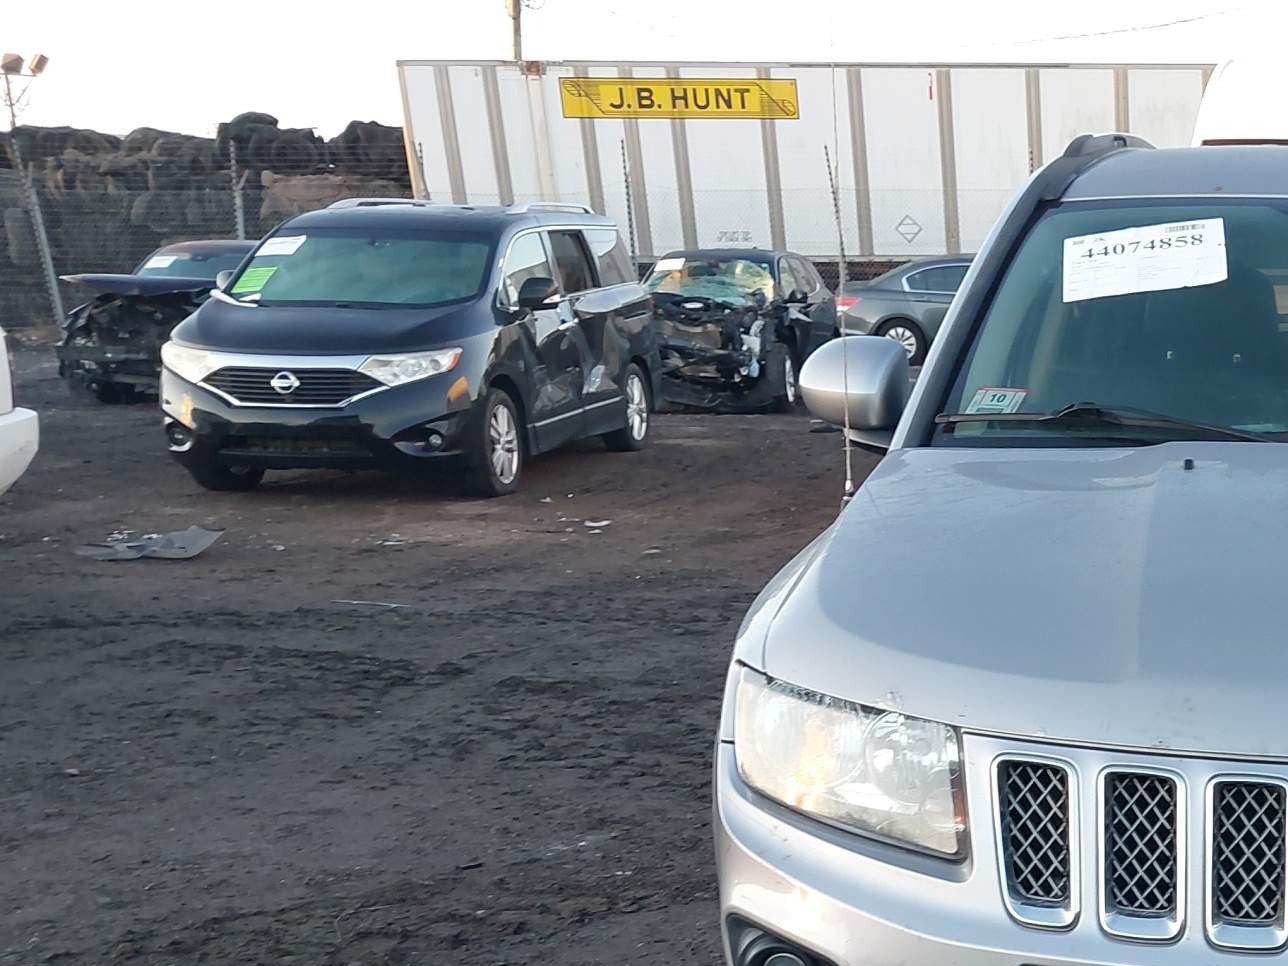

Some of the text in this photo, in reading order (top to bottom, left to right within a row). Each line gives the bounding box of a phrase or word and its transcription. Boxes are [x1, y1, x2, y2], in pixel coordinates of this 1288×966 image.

[609, 87, 751, 110] J.B. HUNT
[1080, 233, 1204, 259] 44074858
[990, 393, 1007, 403] 10
